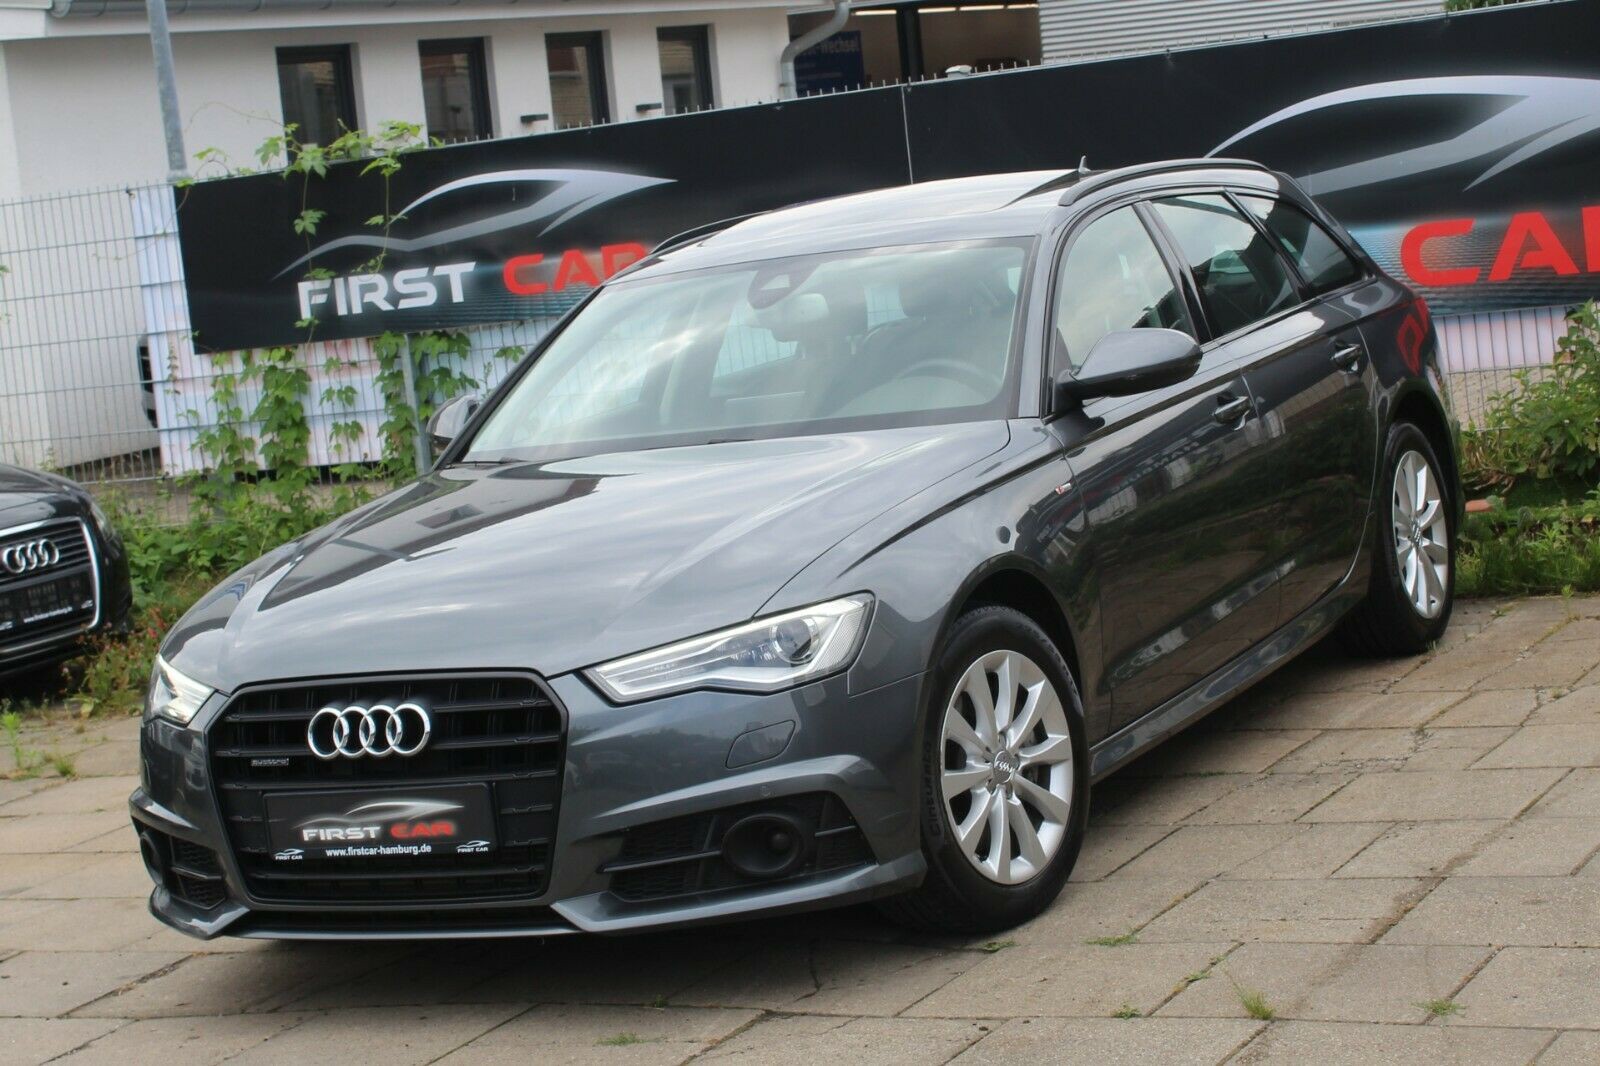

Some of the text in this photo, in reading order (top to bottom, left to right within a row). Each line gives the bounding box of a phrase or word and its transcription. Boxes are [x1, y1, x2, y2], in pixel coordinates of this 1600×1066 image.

[296, 261, 476, 320] FIRST
[302, 820, 454, 842] FIRST CAR
[325, 843, 432, 857] www.firstcar-hamburg.de
